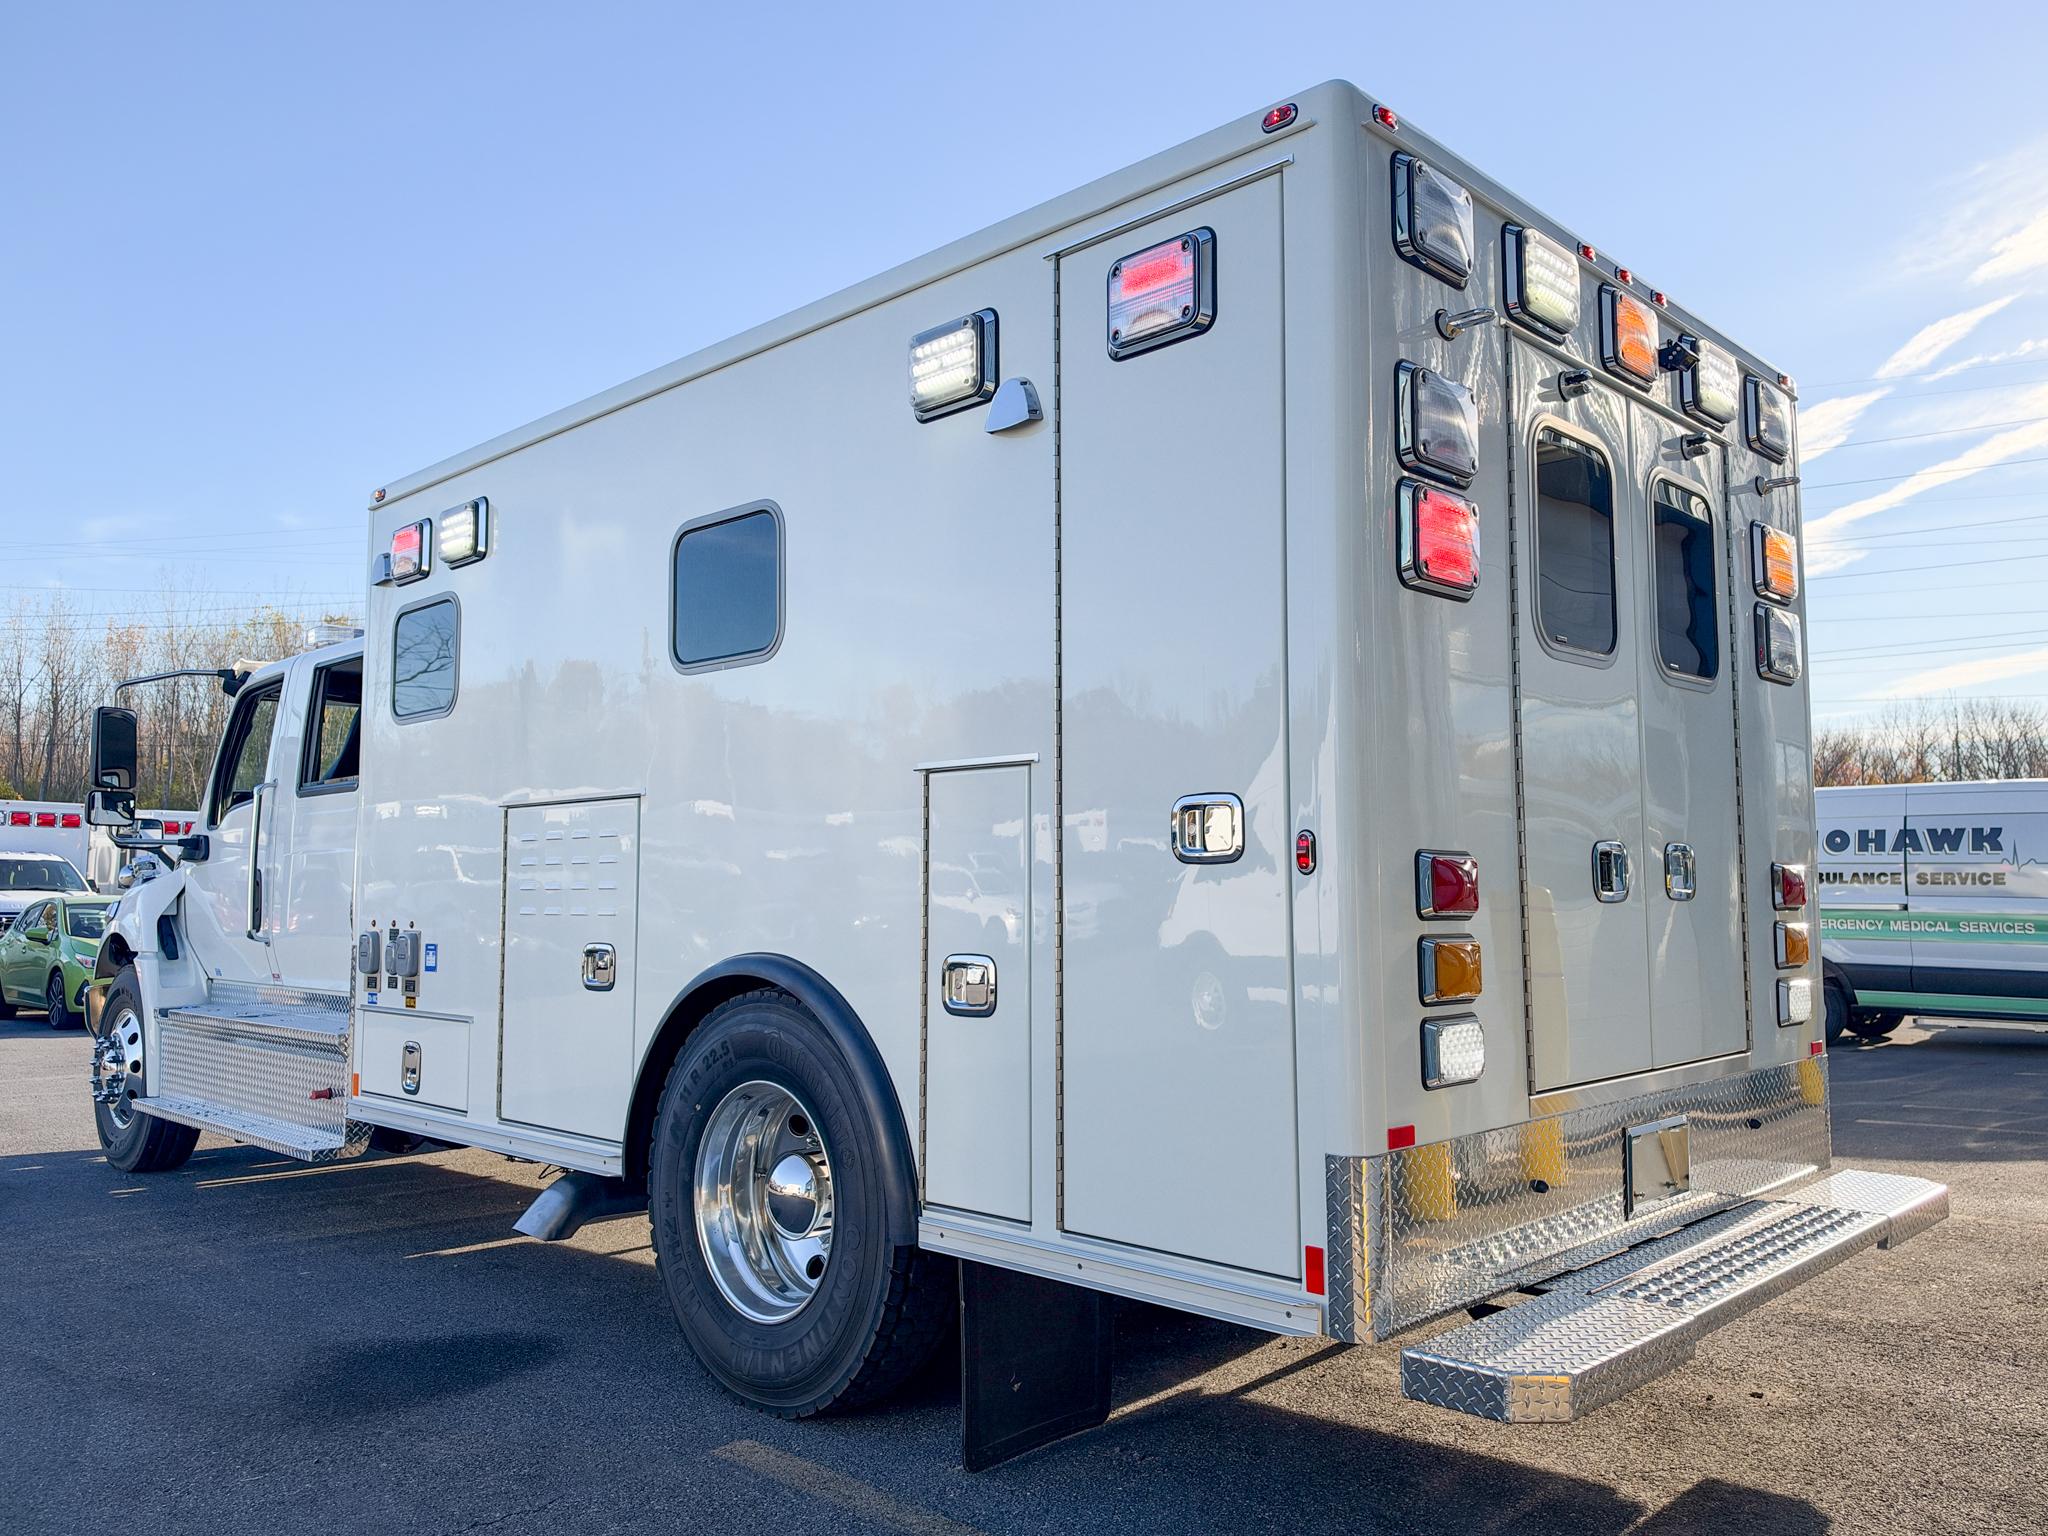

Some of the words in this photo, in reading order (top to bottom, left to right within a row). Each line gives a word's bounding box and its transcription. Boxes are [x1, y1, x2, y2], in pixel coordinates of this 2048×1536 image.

[1817, 827, 2004, 856] OHAWK
[1916, 872, 2007, 886] SERVICE
[1890, 920, 1953, 932] MEDICAL
[1959, 921, 2036, 935] SERVICES
